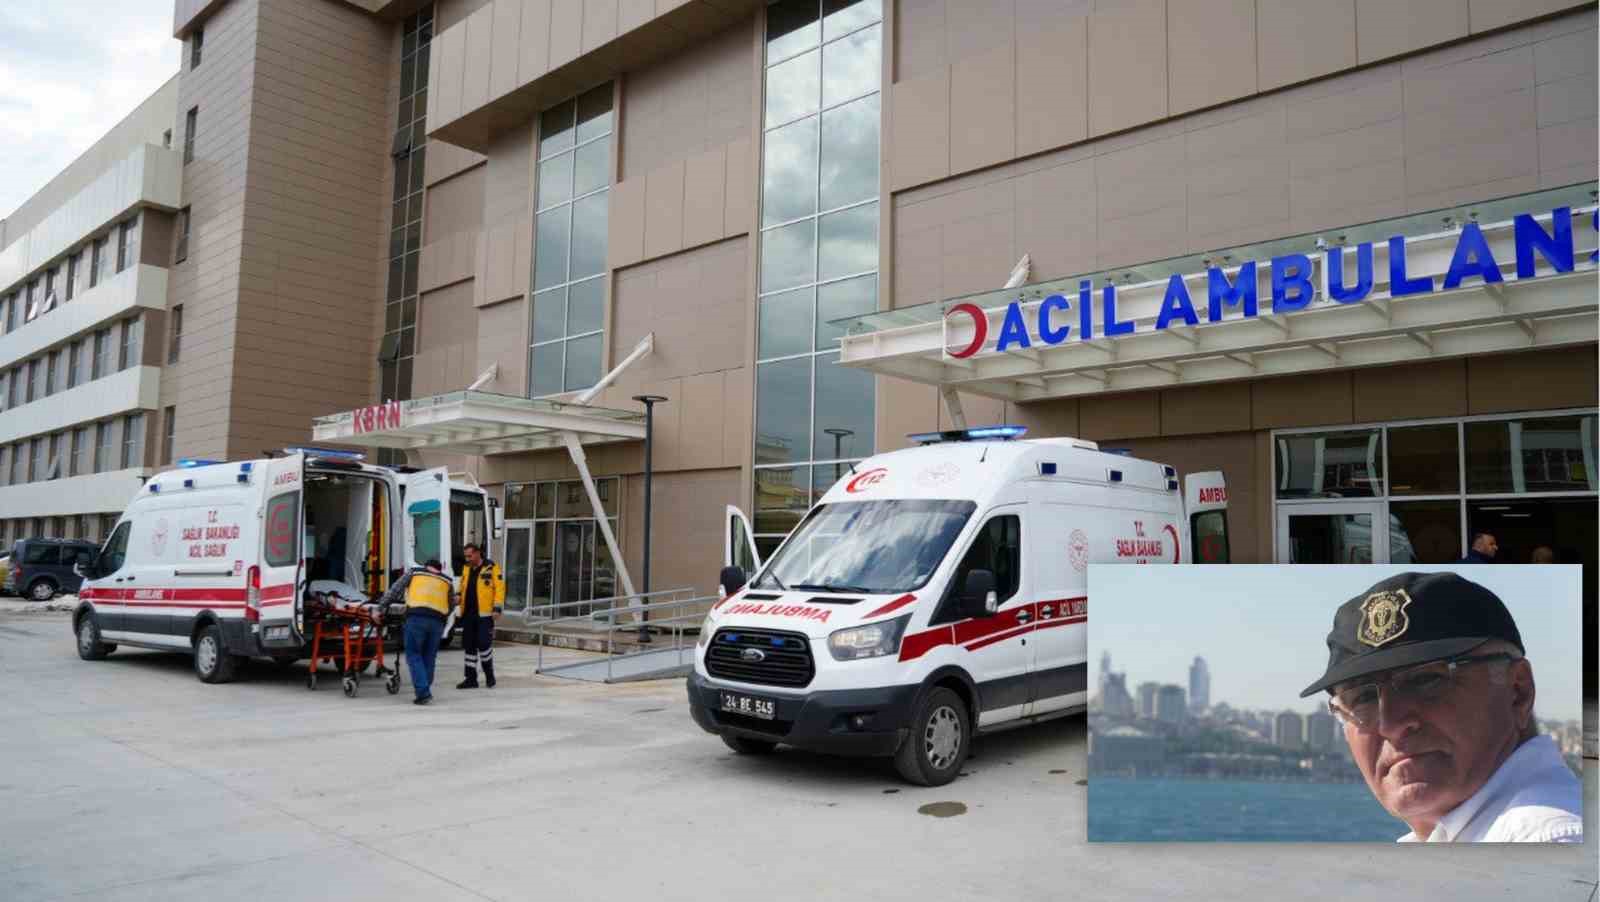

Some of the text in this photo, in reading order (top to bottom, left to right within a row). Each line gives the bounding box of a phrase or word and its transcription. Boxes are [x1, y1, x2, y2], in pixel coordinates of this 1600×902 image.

[996, 206, 1599, 352] ACİL AMBULAN
[352, 401, 400, 433] KBRN
[1199, 487, 1227, 504] AMBU
[725, 695, 773, 715] 24 BE 545
